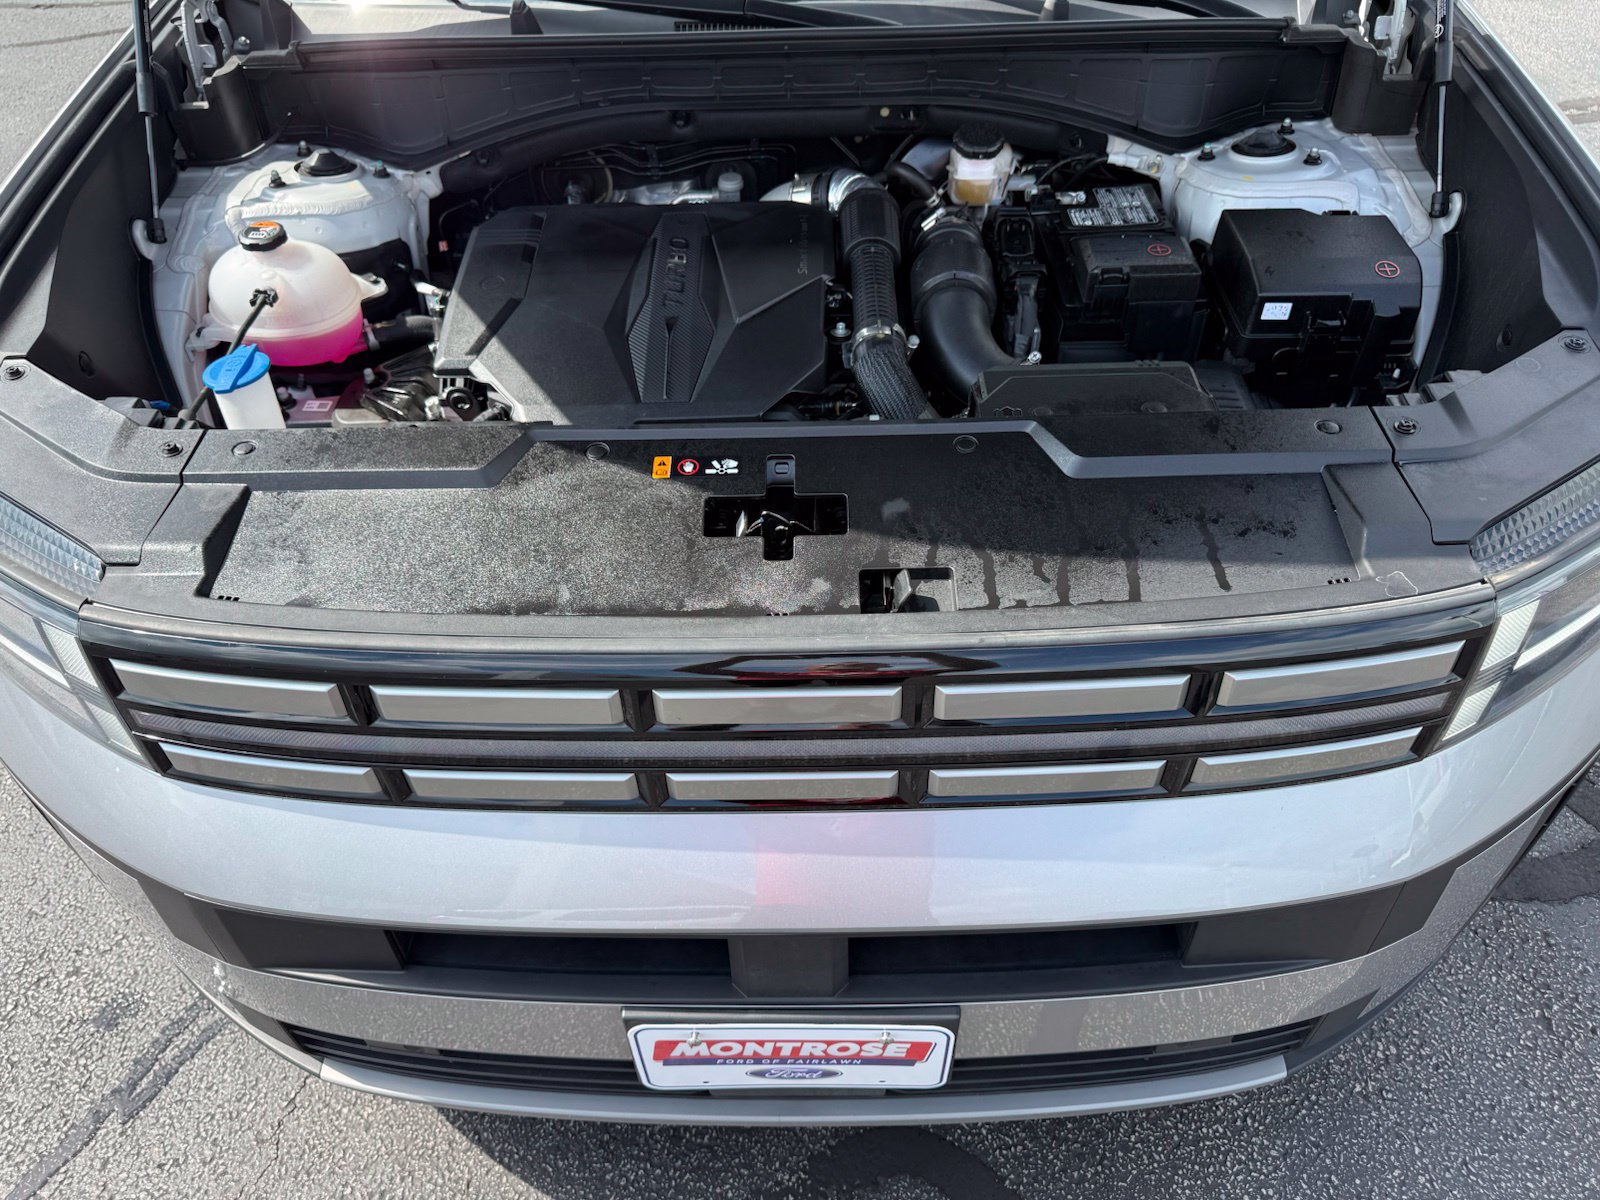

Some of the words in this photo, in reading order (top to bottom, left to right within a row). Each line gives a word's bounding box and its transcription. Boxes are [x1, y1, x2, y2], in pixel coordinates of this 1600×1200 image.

[663, 238, 689, 308] TURBO
[669, 1041, 912, 1058] MONTROSE
[786, 1058, 862, 1066] FAIRLAWN
[764, 1068, 823, 1079] Ford
